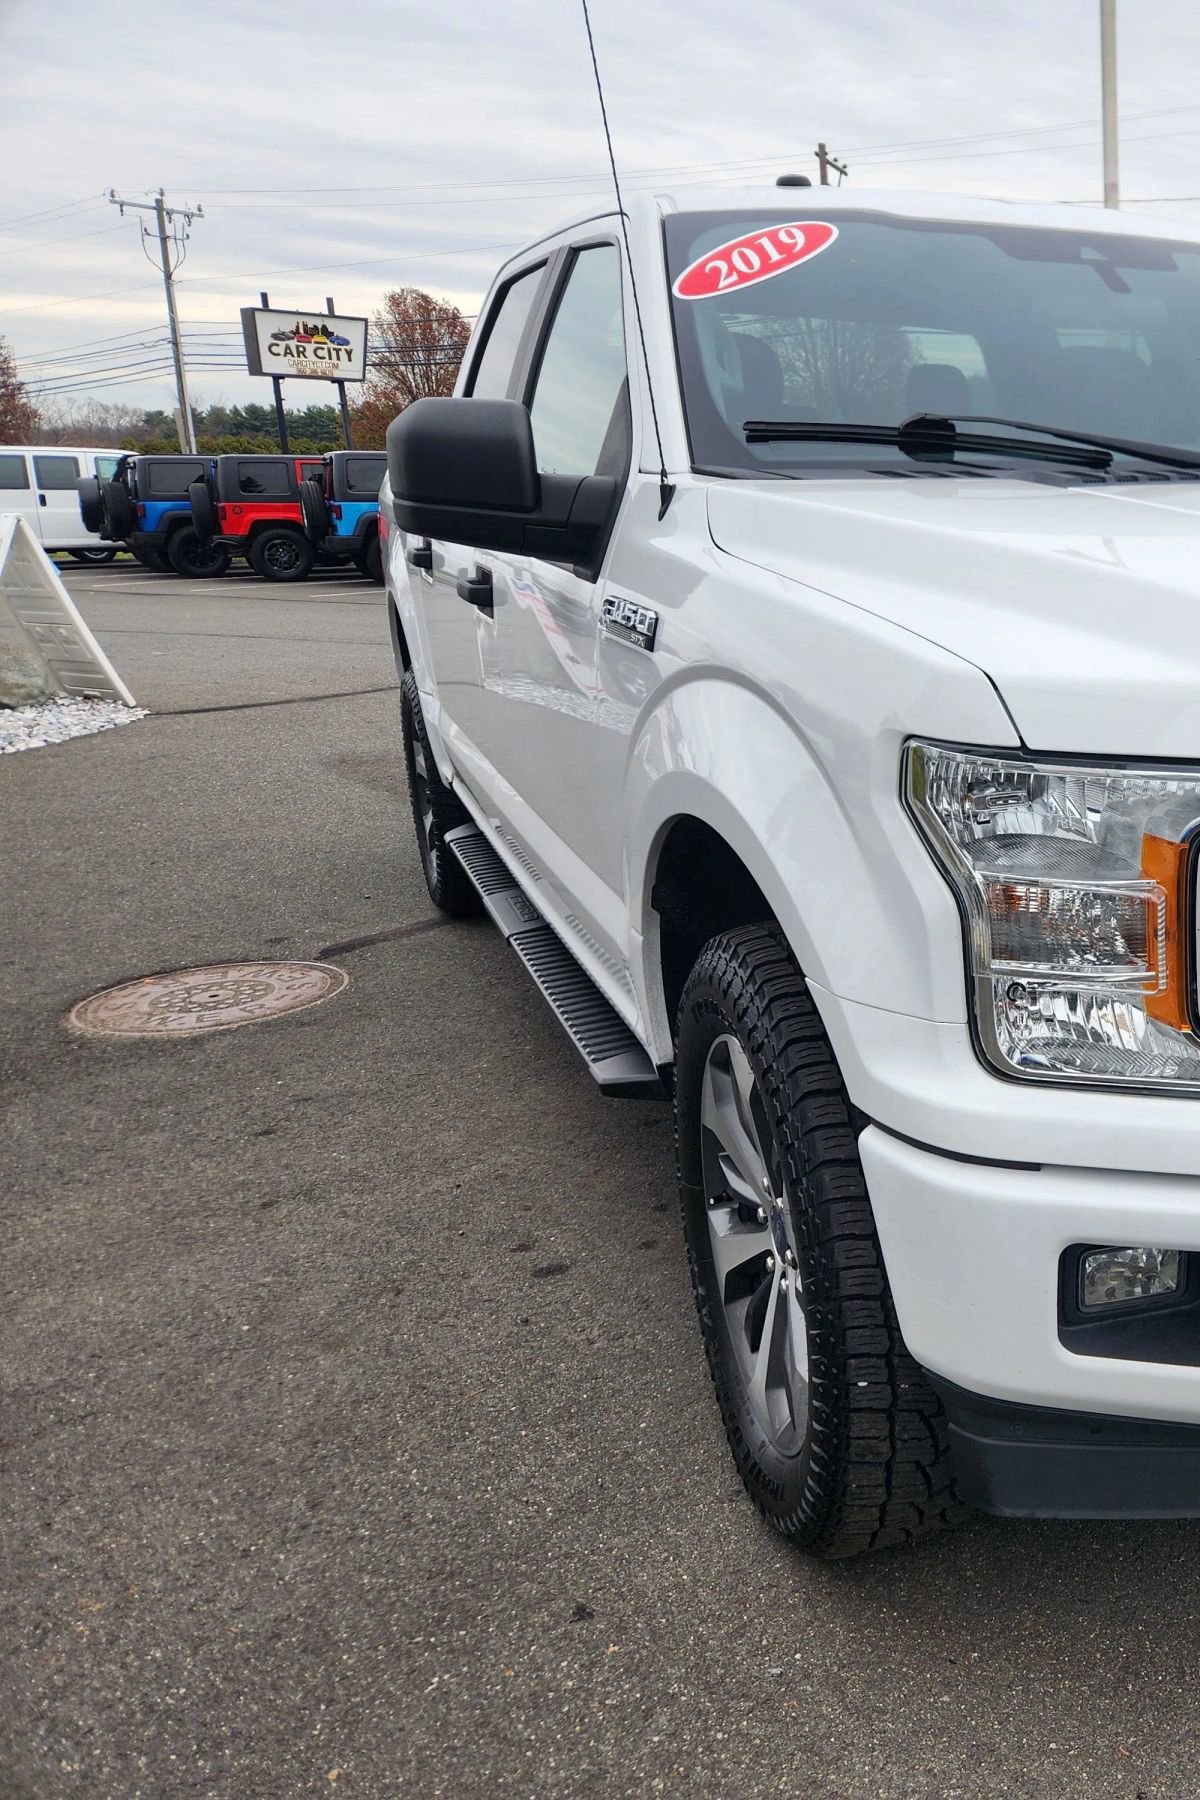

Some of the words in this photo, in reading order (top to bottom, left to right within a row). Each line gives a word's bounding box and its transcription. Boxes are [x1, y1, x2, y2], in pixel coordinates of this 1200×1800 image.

[704, 226, 806, 289] 2019
[268, 342, 308, 359] CAR
[313, 345, 353, 362] CITY
[630, 633, 646, 647] STX
